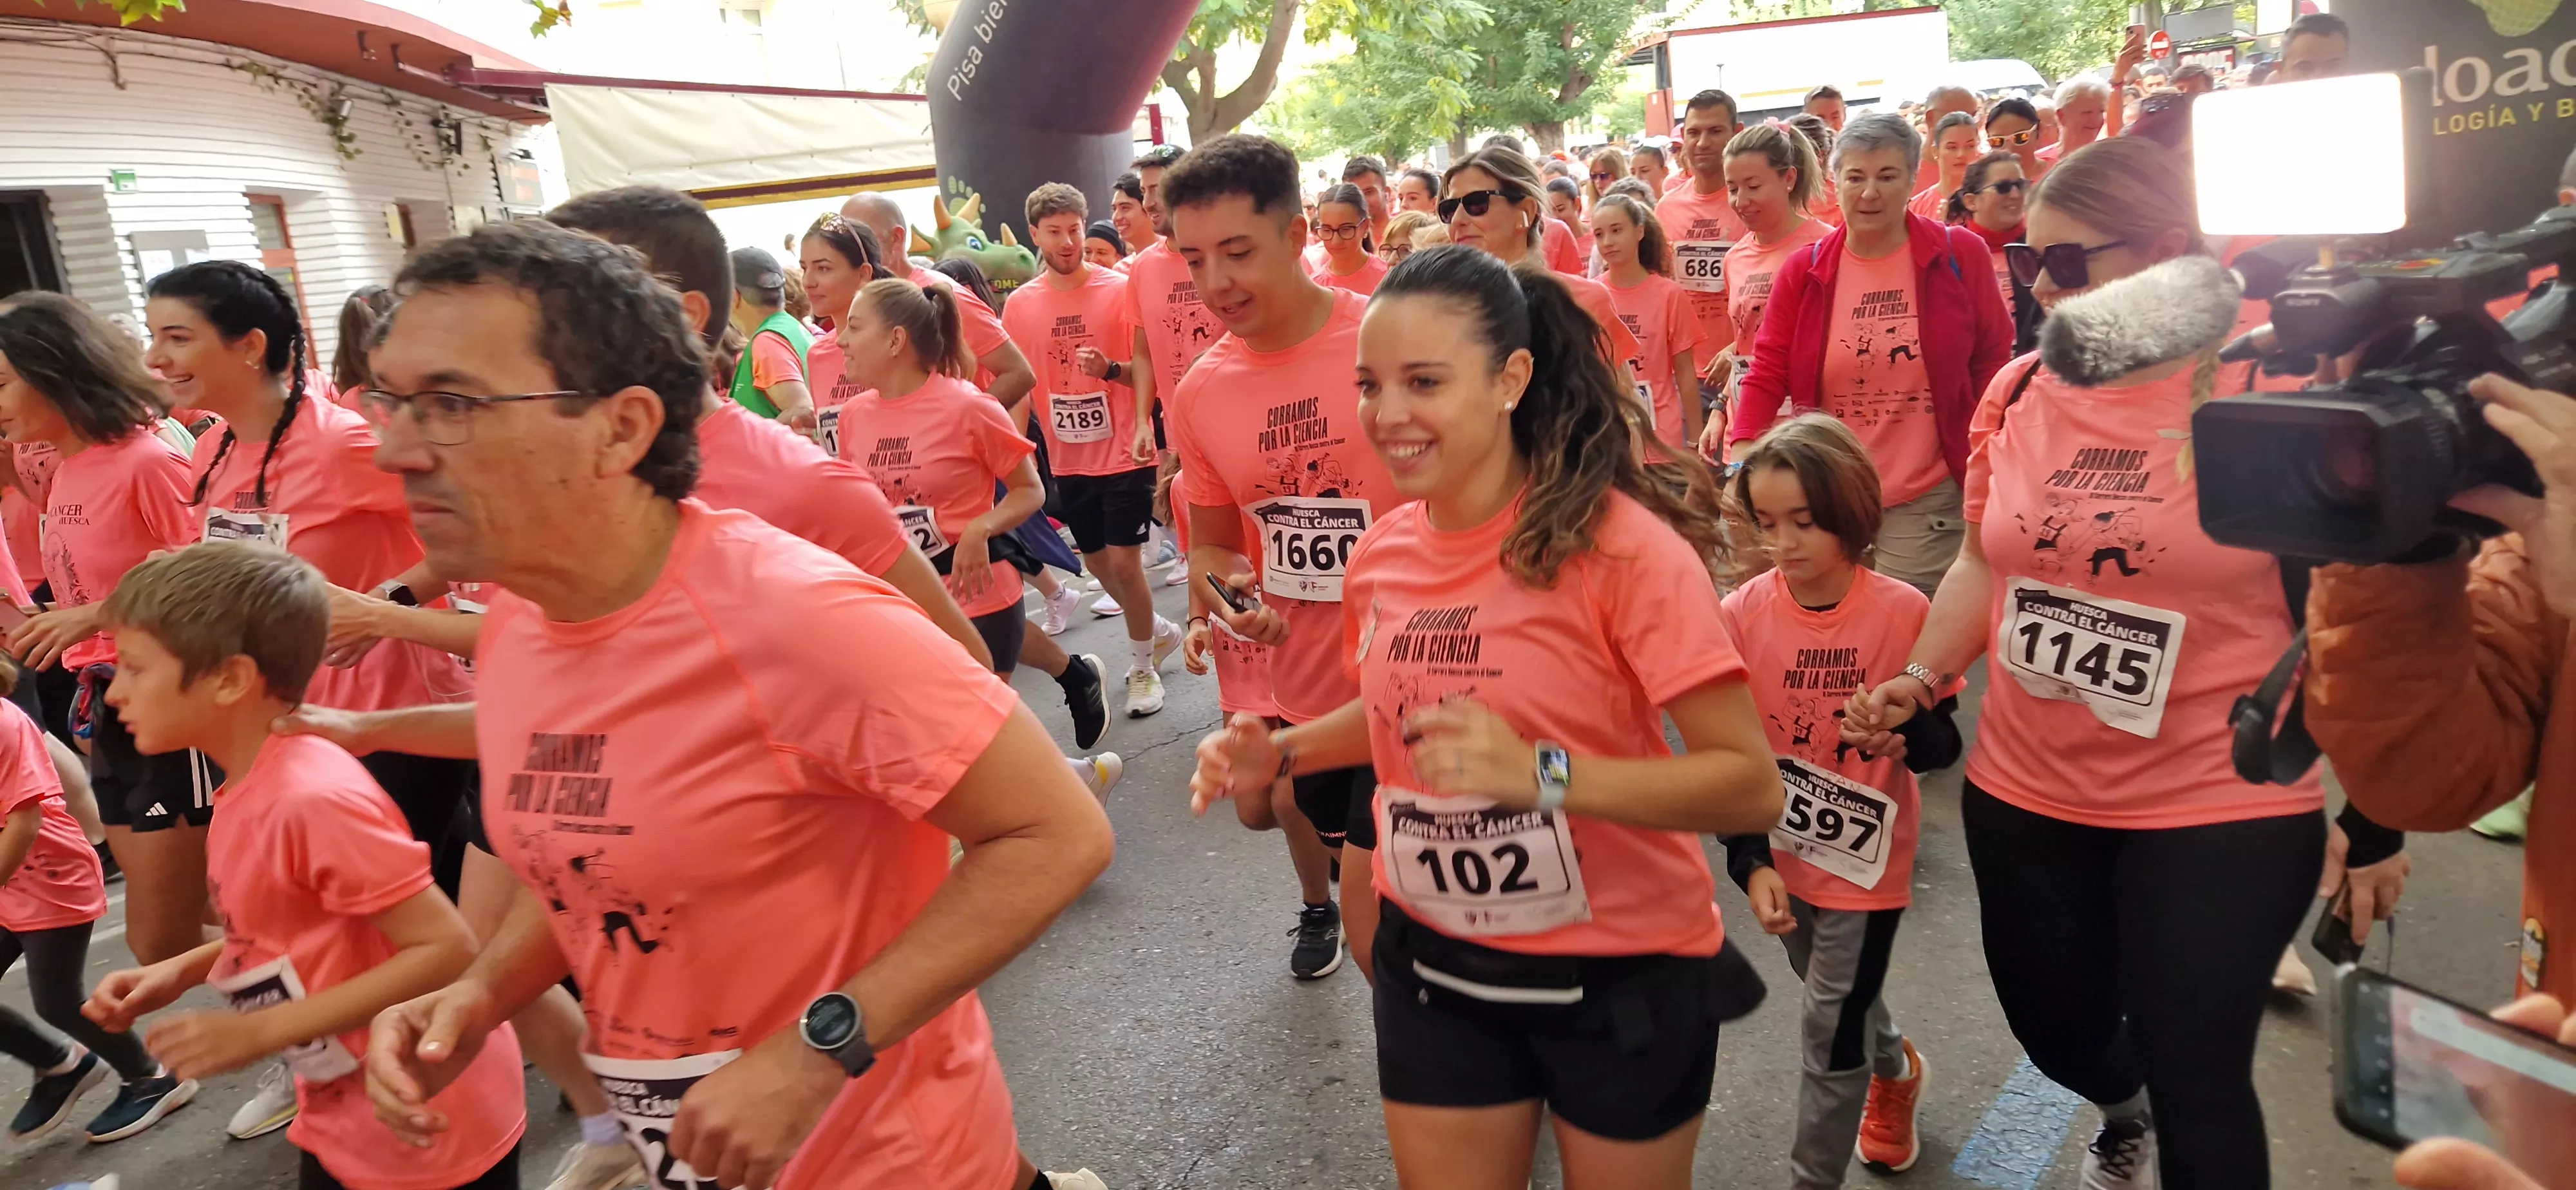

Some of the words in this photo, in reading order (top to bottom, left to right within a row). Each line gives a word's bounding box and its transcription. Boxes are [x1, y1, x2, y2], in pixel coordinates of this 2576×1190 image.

[947, 46, 983, 100] Pisa
[2528, 102, 2544, 122] Y
[1685, 260, 1721, 278] 686
[1861, 289, 1904, 306] CORRAMOS
[1852, 307, 1867, 319] POR
[1868, 305, 1877, 317] LA
[1878, 302, 1909, 316] CIENCIA
[1056, 410, 1104, 429] 2189
[1267, 397, 1319, 429] CORRAMOS
[826, 430, 838, 452] 1
[876, 437, 909, 452] CORRAMOS
[1258, 430, 1278, 453] POR
[1280, 426, 1291, 448] LA
[1294, 417, 1328, 444] CIENCIA
[867, 452, 880, 468] POR
[880, 451, 887, 467] LA
[888, 451, 912, 466] CIENCIA
[2070, 448, 2148, 471] CORRAMOS
[2044, 469, 2079, 488] POR
[2074, 471, 2096, 490] LA
[2093, 471, 2150, 493] CIENCIA
[1267, 514, 1300, 527] CONTRA
[1300, 518, 1312, 527] EL
[1314, 516, 1359, 528] CÁNCER
[1292, 508, 1320, 518] HUESCA
[1272, 529, 1359, 571] 1660
[1405, 605, 1479, 631] CORRAMOS
[2070, 602, 2108, 621] HUESCA
[2024, 601, 2076, 625] CONTRA
[2078, 617, 2093, 630] EL
[2096, 621, 2158, 646] CÁNCER
[1387, 633, 1412, 663] POR
[1410, 634, 1426, 663] LA
[1428, 632, 1481, 665] CIENCIA
[1796, 647, 1858, 669] CORRAMOS
[2018, 621, 2152, 695] 1145
[1783, 670, 1805, 689] POR
[1807, 670, 1820, 690] LA
[1823, 668, 1866, 690] CIENCIA
[1780, 770, 1813, 793] ONTRA
[1815, 788, 1828, 800] EL
[1830, 795, 1877, 818] CÁNCER
[1808, 773, 1839, 794] HUESCA
[1398, 817, 1450, 840] CONTRA
[1452, 825, 1472, 840] EL
[1474, 811, 1544, 838] CÁNCER
[1434, 811, 1482, 826] HUESCA
[1783, 786, 1877, 852] 597
[1417, 844, 1539, 894] 102
